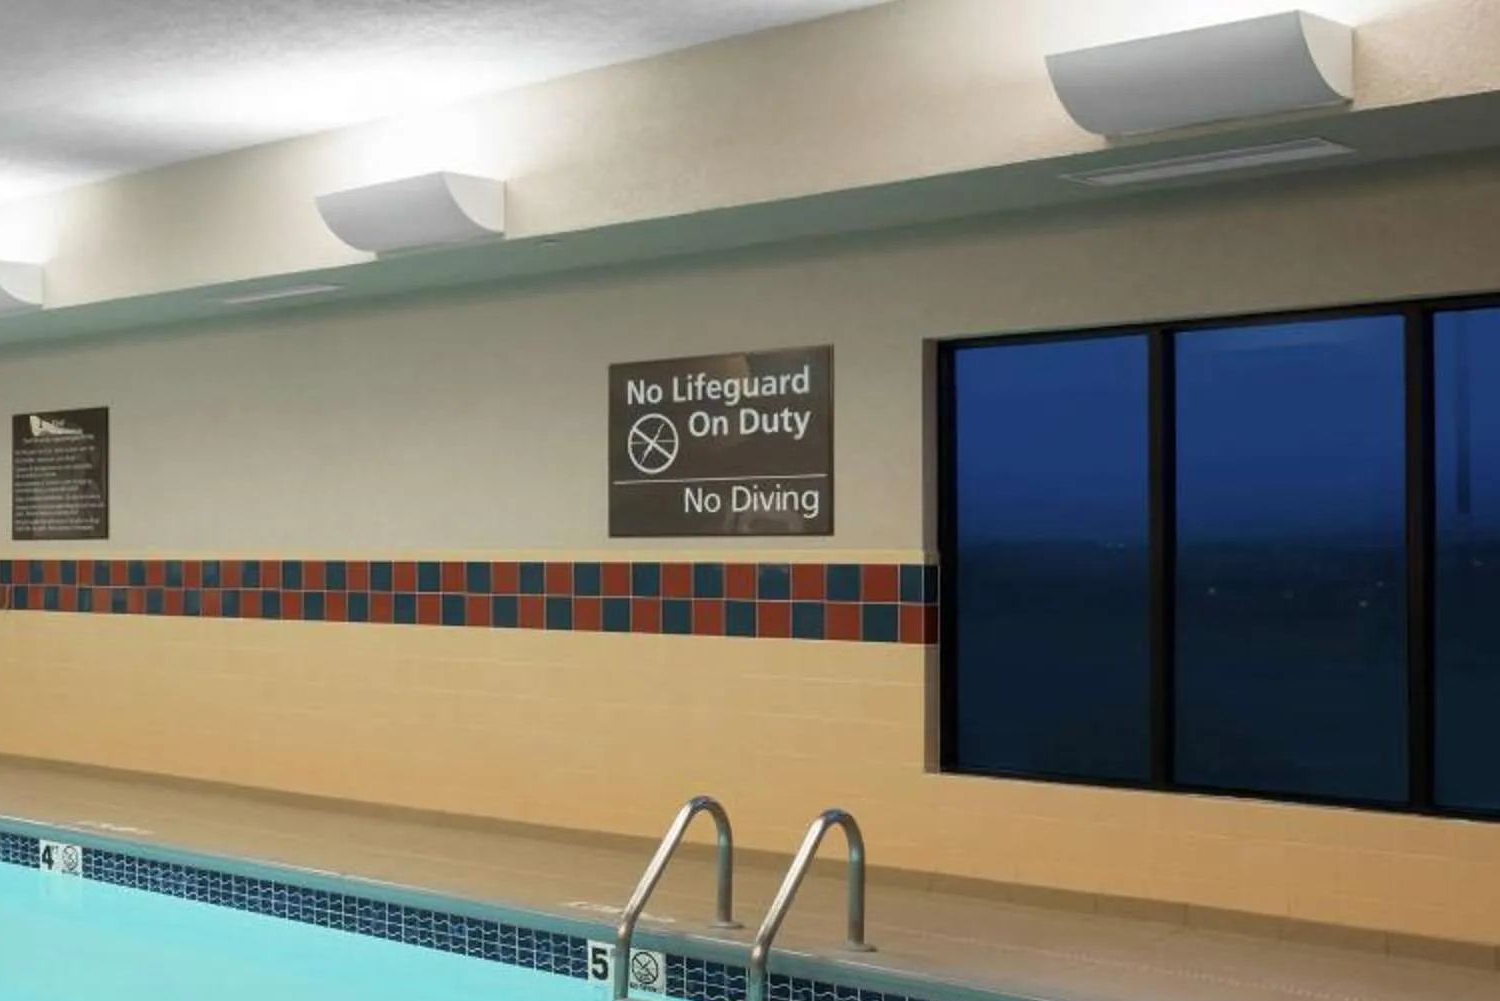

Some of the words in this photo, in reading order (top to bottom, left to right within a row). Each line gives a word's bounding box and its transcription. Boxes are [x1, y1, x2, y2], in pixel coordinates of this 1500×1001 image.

[626, 379, 663, 405] No
[672, 364, 810, 406] Lifeguard
[688, 411, 729, 437] On
[739, 408, 811, 440] Duty
[684, 486, 721, 513] No
[731, 484, 820, 519] Diving
[41, 845, 54, 871] 4
[591, 946, 609, 981] 5
